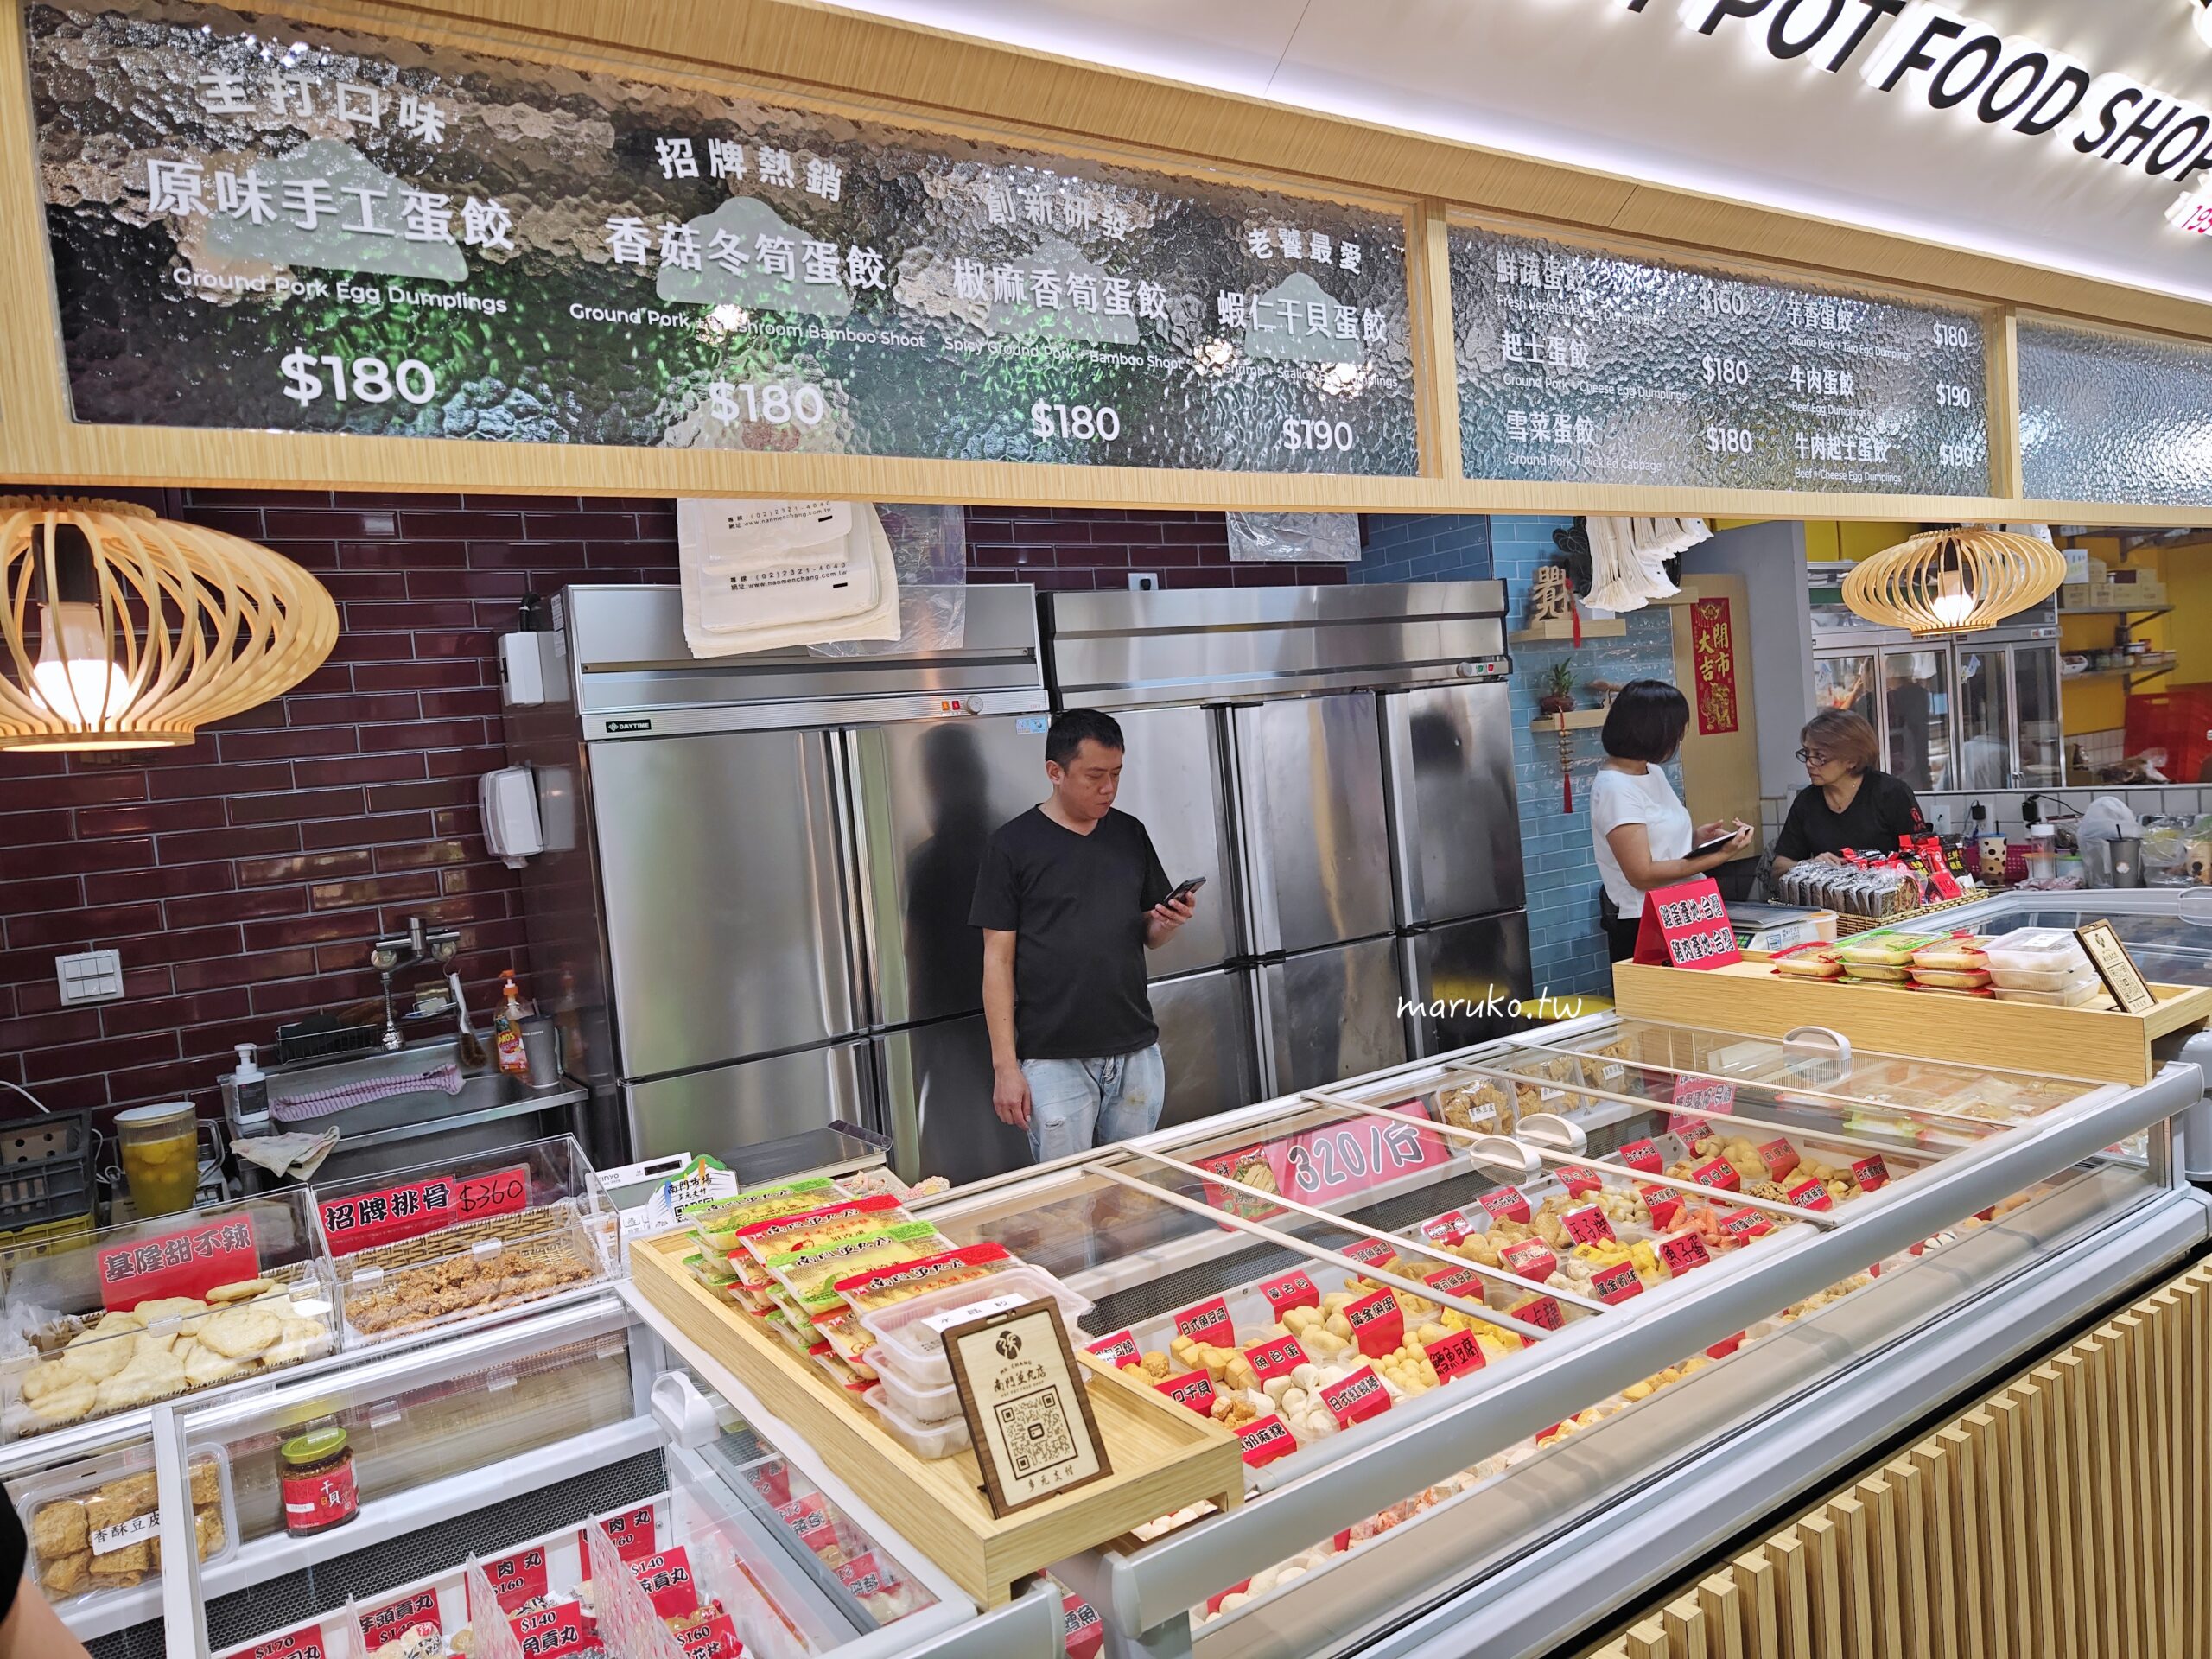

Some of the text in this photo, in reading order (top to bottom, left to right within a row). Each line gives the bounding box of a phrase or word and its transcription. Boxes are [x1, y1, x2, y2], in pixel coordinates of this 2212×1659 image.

[1878, 16, 2090, 136] FOOD
[198, 67, 446, 145] 主打口味
[654, 137, 842, 203] 招牌熱銷
[146, 159, 516, 251] 原味手工蛋餃
[987, 188, 1131, 242] 創新研發
[605, 216, 887, 291] 香菇冬筍蛋餃
[173, 267, 508, 315] Ground Pork Egg Dumplings
[953, 257, 1167, 321] 椒麻香筍蛋餃
[1496, 252, 1586, 295] 鮮蔬蛋餃
[569, 303, 641, 325] Ground
[647, 309, 690, 328] Pork
[809, 324, 876, 344] Bamboo
[881, 330, 925, 348] Shoot
[1217, 289, 1388, 343] 蝦仁干貝蛋餃
[1501, 330, 1591, 370] 起士蛋餃
[1933, 320, 1968, 348] $180
[944, 339, 1183, 370] Spicy Ground Pork Bamboo Shoot
[1702, 353, 1750, 385] $180
[1875, 346, 1912, 361] Dumplings
[280, 347, 435, 407] $180
[1503, 373, 1687, 403] Ground Pork Cheese Egg Dumplings
[1790, 365, 1854, 398] 牛肉蛋餃
[1936, 380, 1971, 409] $190
[708, 378, 823, 426] $180
[1031, 400, 1120, 442] $180
[1282, 416, 1353, 452] $190
[1506, 410, 1596, 447] 雪菜蛋餃
[1707, 423, 1753, 455] $180
[1795, 432, 1889, 464] 牛肉起士蛋餃
[1698, 630, 1715, 683] 大吉
[1713, 621, 1730, 678] 開市
[668, 1173, 712, 1195] 南門市場
[324, 1179, 524, 1231] 招牌排骨 $360
[105, 1225, 251, 1283] 基隆甜不辣
[1267, 1277, 1309, 1300] 蒙古包
[1596, 1268, 1639, 1298] 黃金蝦球
[1180, 1306, 1228, 1337] 日式魚豆腐
[1350, 1295, 1397, 1328] 黃金魚蛋
[1253, 1344, 1302, 1370] 魚包蛋
[1027, 1465, 1074, 1492] 多元支付
[94, 1510, 161, 1545] 香酥豆皮
[610, 1534, 634, 1549] 160
[487, 1552, 543, 1578] 肉丸
[631, 1555, 664, 1576] $140
[359, 1594, 434, 1632] 芋頭貢丸
[521, 1611, 557, 1633] $140
[255, 1637, 295, 1658] $170
[676, 1625, 710, 1647] $160
